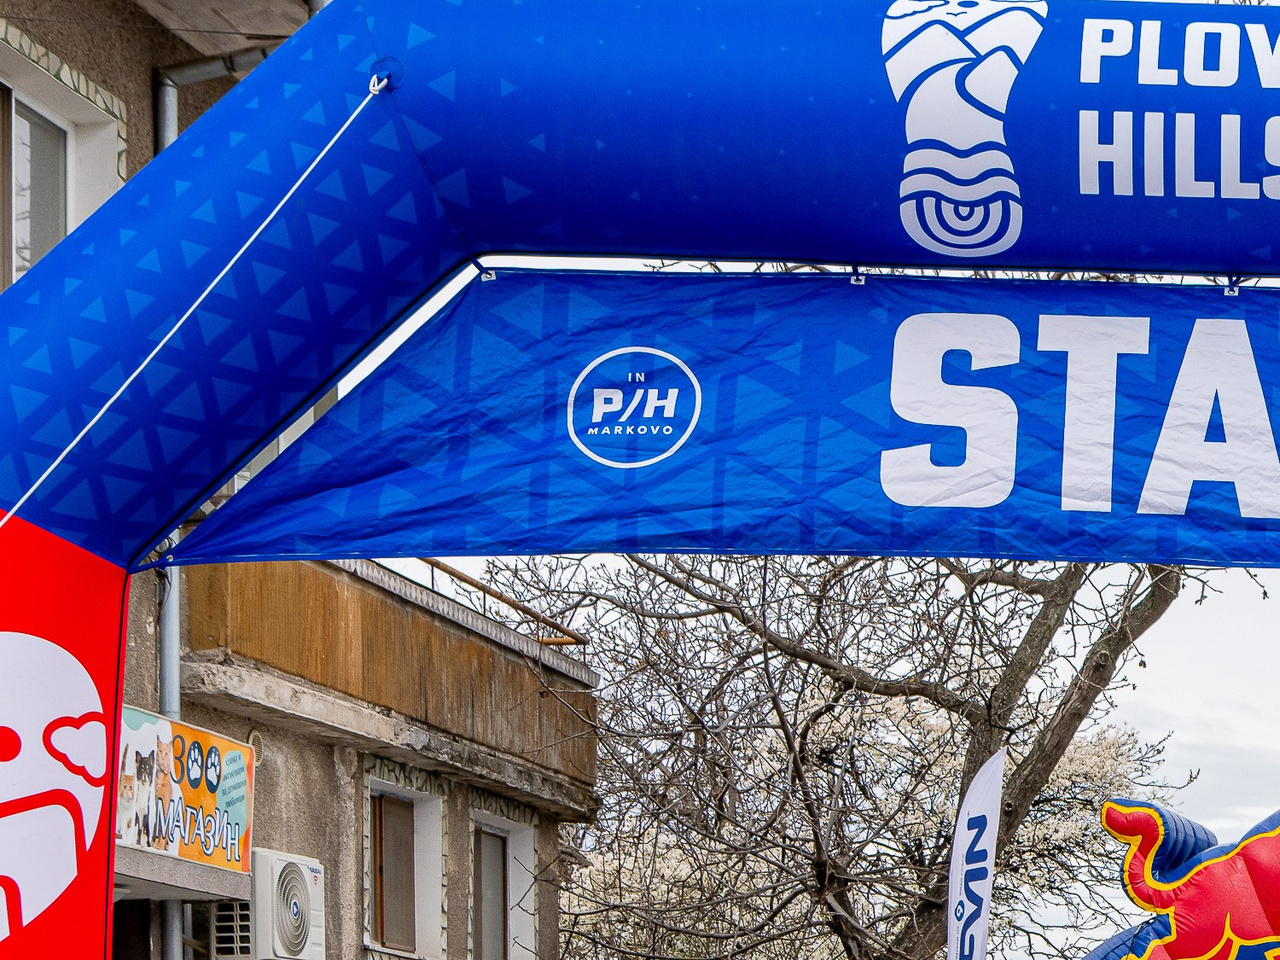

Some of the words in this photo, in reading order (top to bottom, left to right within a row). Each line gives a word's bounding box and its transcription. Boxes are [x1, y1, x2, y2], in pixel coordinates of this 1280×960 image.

[628, 372, 645, 382] IN
[591, 388, 679, 423] P/H
[587, 425, 673, 435] MARKOVO
[154, 796, 241, 862] МАГАЗИН
